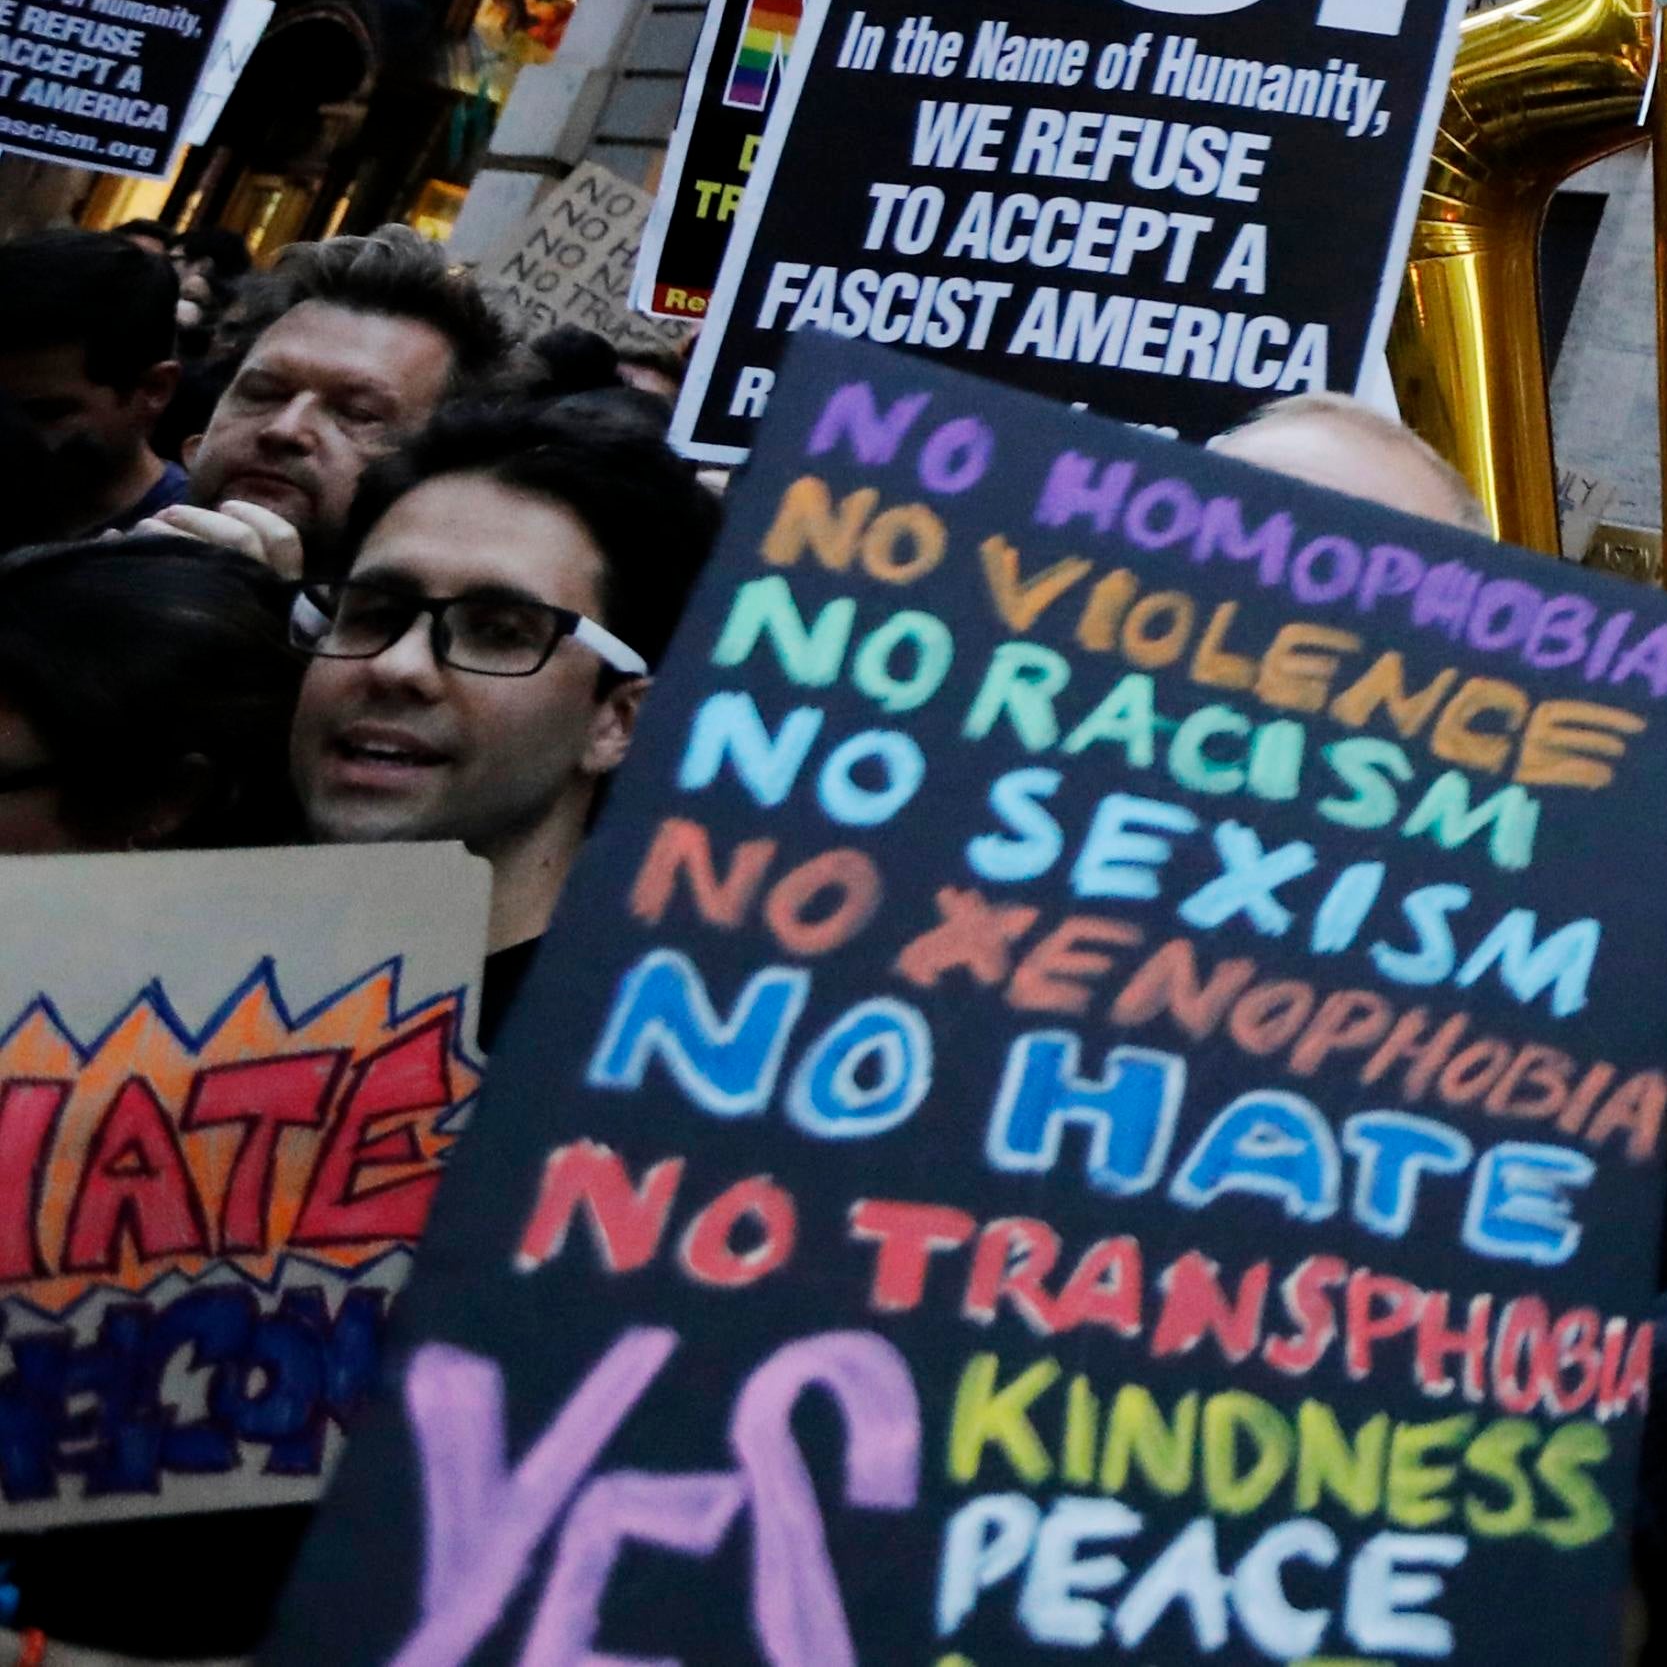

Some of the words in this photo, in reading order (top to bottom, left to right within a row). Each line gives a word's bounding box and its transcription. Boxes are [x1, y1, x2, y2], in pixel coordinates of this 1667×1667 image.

[18, 5, 146, 57] REFUSE
[117, 64, 143, 92] A
[838, 11, 879, 72] In
[897, 17, 957, 80] the
[966, 22, 1086, 90] Name
[1097, 32, 1149, 93] of
[1153, 39, 1392, 137] Humanity,
[0, 115, 157, 166] ascism.org
[19, 77, 169, 132] AMERICA
[911, 100, 1011, 172] WE
[1011, 109, 1272, 202] REFUSE
[525, 227, 587, 269] NO
[552, 199, 610, 242] NO
[575, 176, 636, 217] NO
[862, 183, 945, 256] TO
[944, 192, 1212, 285] ACCEPT
[1213, 224, 1266, 294] A
[756, 263, 1012, 352] FASCIST
[1008, 287, 1329, 394] AMERICA
[805, 379, 993, 496] NO
[757, 475, 948, 587] NO
[979, 536, 1646, 791] VIOLENCE
[711, 574, 957, 715] NO
[962, 640, 1540, 872] RACISM
[628, 815, 882, 958] NO
[677, 692, 929, 827] NO
[965, 767, 1604, 1021] SEXISM
[587, 946, 936, 1142] NO
[984, 1029, 1599, 1267] HATE
[513, 1140, 800, 1289] NO
[950, 1349, 1617, 1551] KINDNESS
[936, 1494, 1470, 1659] PEACE
